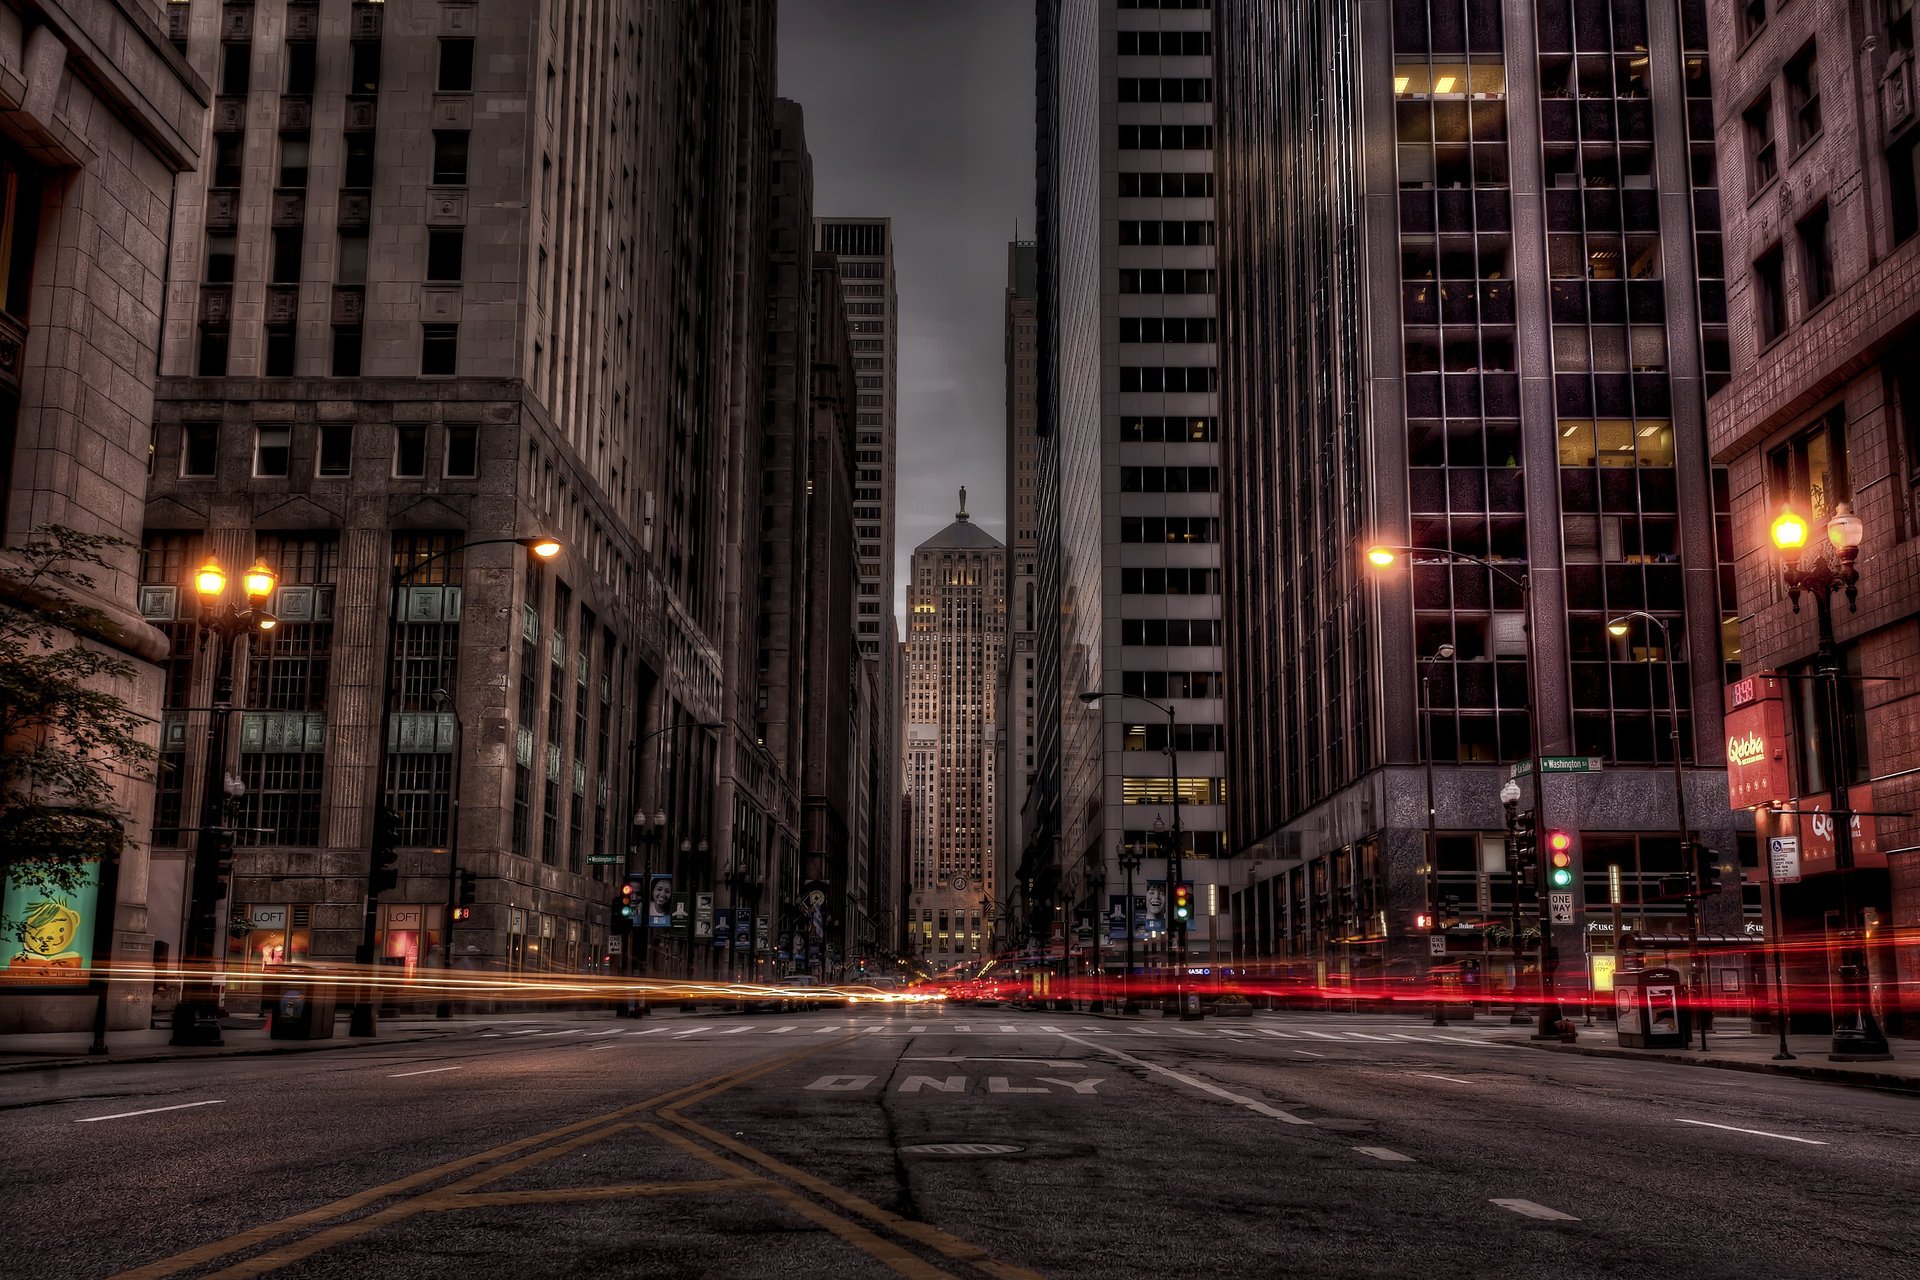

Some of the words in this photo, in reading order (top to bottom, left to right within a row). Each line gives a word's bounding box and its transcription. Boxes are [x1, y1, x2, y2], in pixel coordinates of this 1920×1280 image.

[1728, 731, 1763, 766] Qdoba
[1548, 759, 1581, 771] Washington
[1552, 895, 1570, 903] ONE
[1552, 904, 1571, 912] WAY
[254, 912, 284, 922] LOFT
[389, 912, 419, 922] LOFT
[803, 1075, 1106, 1094] ONLY
